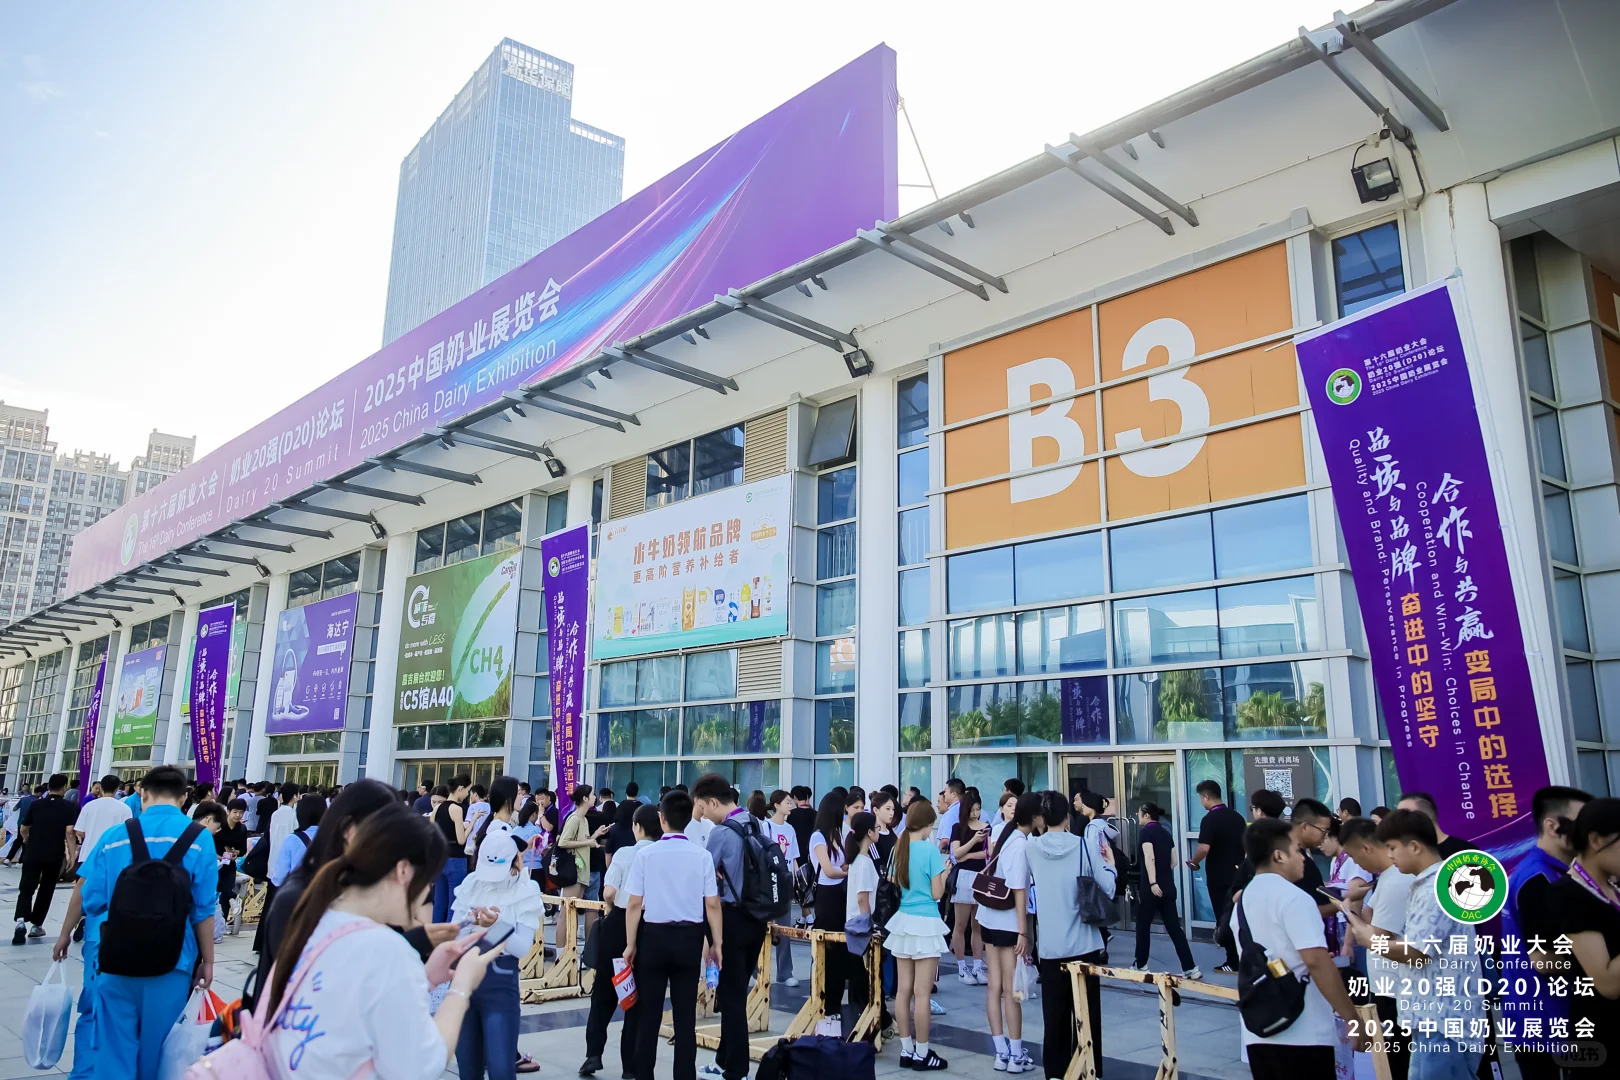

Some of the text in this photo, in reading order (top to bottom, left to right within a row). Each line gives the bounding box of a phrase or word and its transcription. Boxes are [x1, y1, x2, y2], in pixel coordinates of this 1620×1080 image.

[363, 277, 561, 413] 2025中国奶业展览会
[1363, 337, 1427, 367] 第十六届奶业大会
[1367, 345, 1445, 379] 奶业20强(D20)论坛
[1370, 357, 1448, 391] 2025中国奶业展览会
[359, 338, 557, 449] 2025 China Dairy Exhibition
[1006, 317, 1210, 504] B3
[229, 398, 345, 487] 奶业20强(D20)论坛
[140, 469, 219, 533] 第十六届奶业大会
[226, 443, 339, 513] Dairy 20 Summit
[139, 540, 149, 556] The
[159, 527, 176, 546] Dairy
[176, 509, 213, 537] Conference
[633, 517, 741, 566] 水牛奶领航品牌
[633, 548, 740, 585] 更高阶营养补给者
[1349, 439, 1413, 748] Quality and Brand: Perseverance in Progress
[1366, 426, 1440, 748] 品质与品牌 奋进中的坚守
[326, 619, 349, 638] 海达宁
[470, 645, 504, 674] CH4
[1416, 481, 1475, 820] Cooperation and Win-Win: Choices in Change
[1431, 472, 1518, 819] 合作与共赢 变局中的选择
[404, 685, 454, 710] C5馆A40
